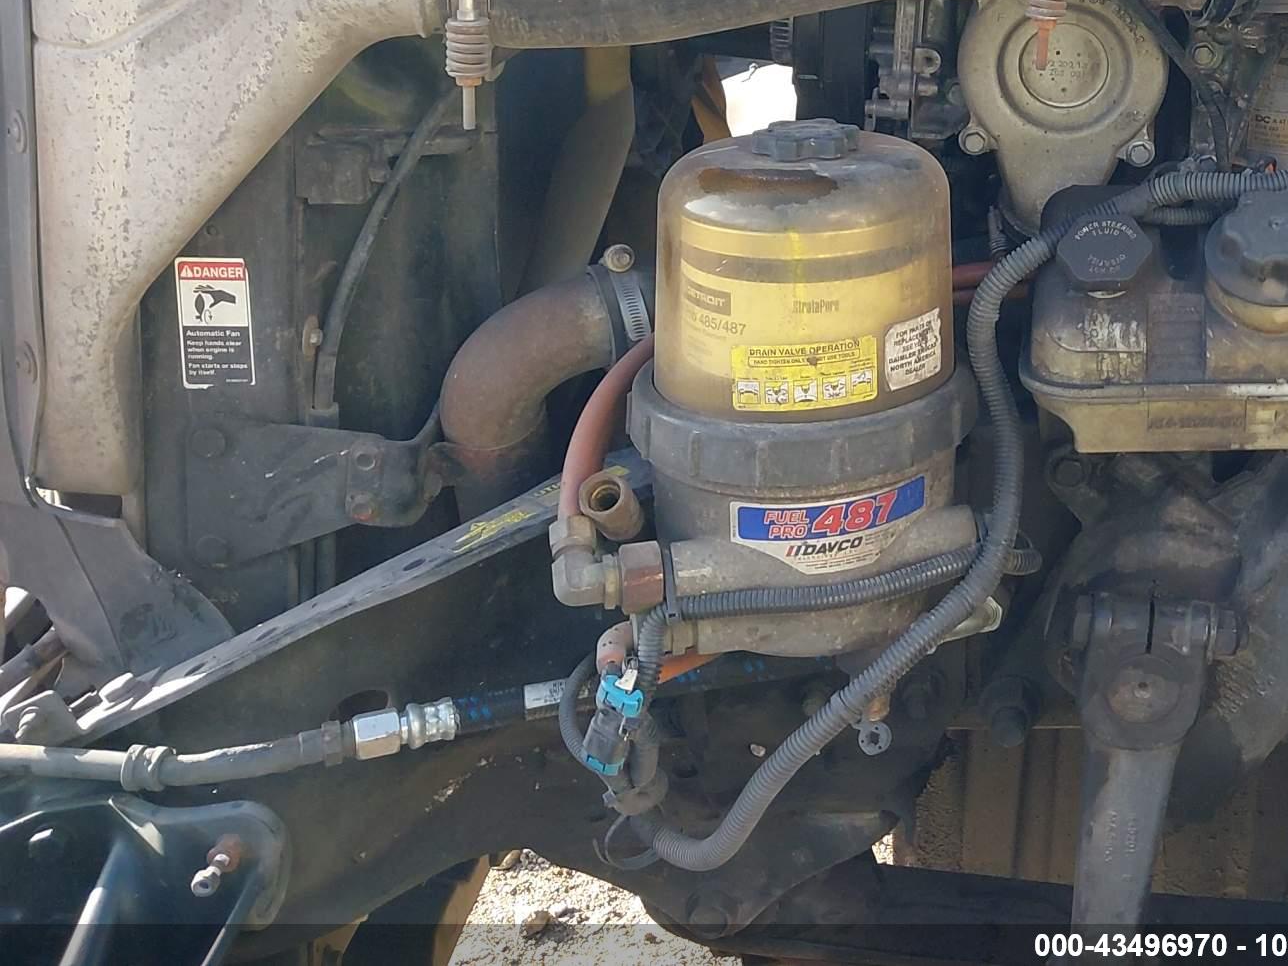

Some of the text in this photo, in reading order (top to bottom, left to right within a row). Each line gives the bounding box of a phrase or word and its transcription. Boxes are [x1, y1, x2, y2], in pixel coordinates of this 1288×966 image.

[193, 266, 244, 279] DANGER
[896, 329, 908, 339] FOR
[749, 340, 860, 356] DRAIN VALVE OPERATION
[889, 350, 916, 364] DAIMLER
[890, 360, 912, 372] NORTH
[914, 350, 936, 364] AMERICA
[905, 363, 926, 376] DEALER
[763, 509, 810, 525] FUEL
[811, 491, 898, 535] 487
[768, 524, 808, 540] PRO
[803, 536, 863, 556] DAVCO
